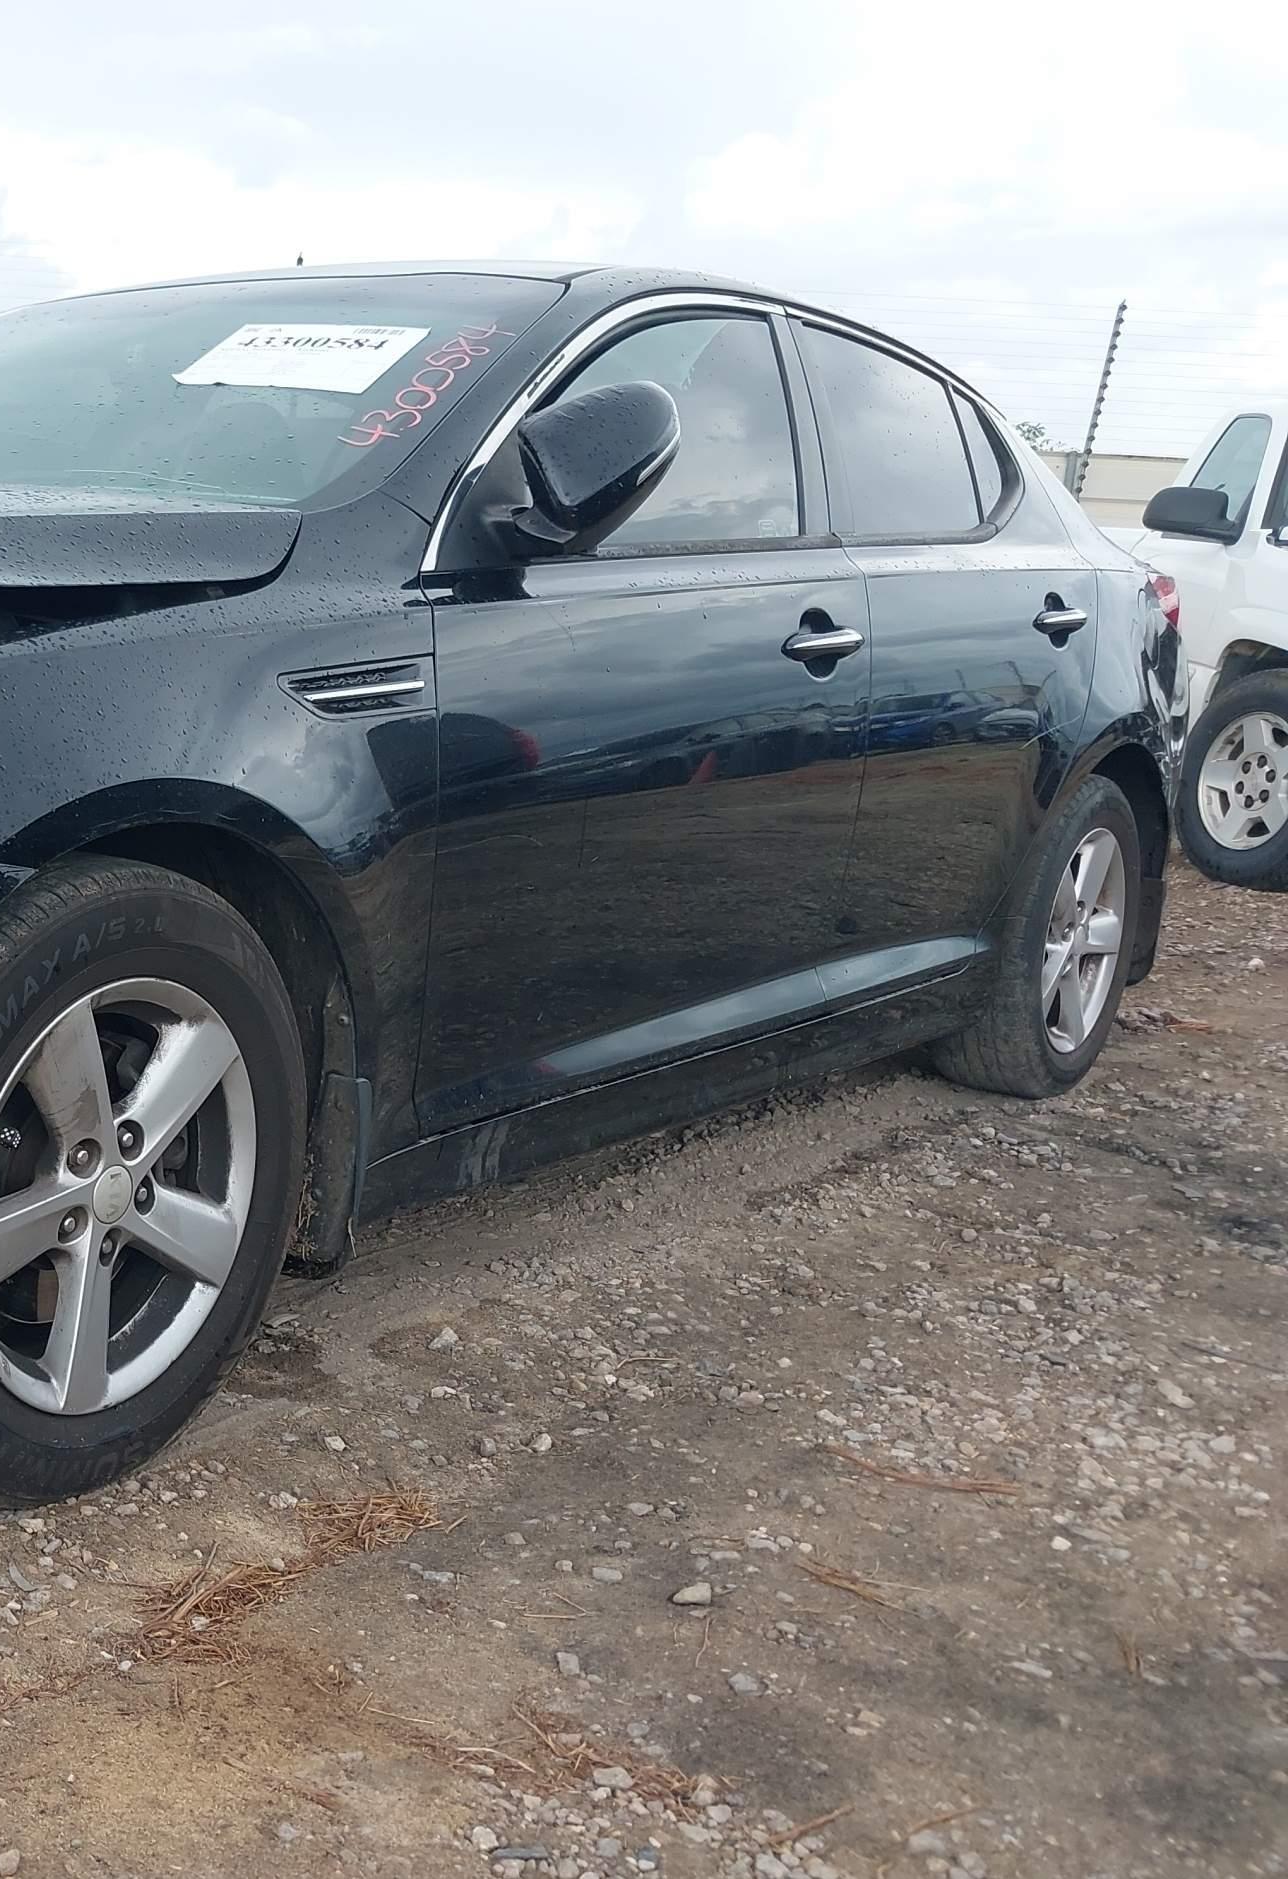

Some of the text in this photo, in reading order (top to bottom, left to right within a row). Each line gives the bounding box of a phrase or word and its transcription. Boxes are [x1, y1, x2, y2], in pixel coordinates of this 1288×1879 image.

[238, 336, 390, 351] 43300584
[337, 320, 517, 447] 4300584
[72, 917, 126, 961] A/S
